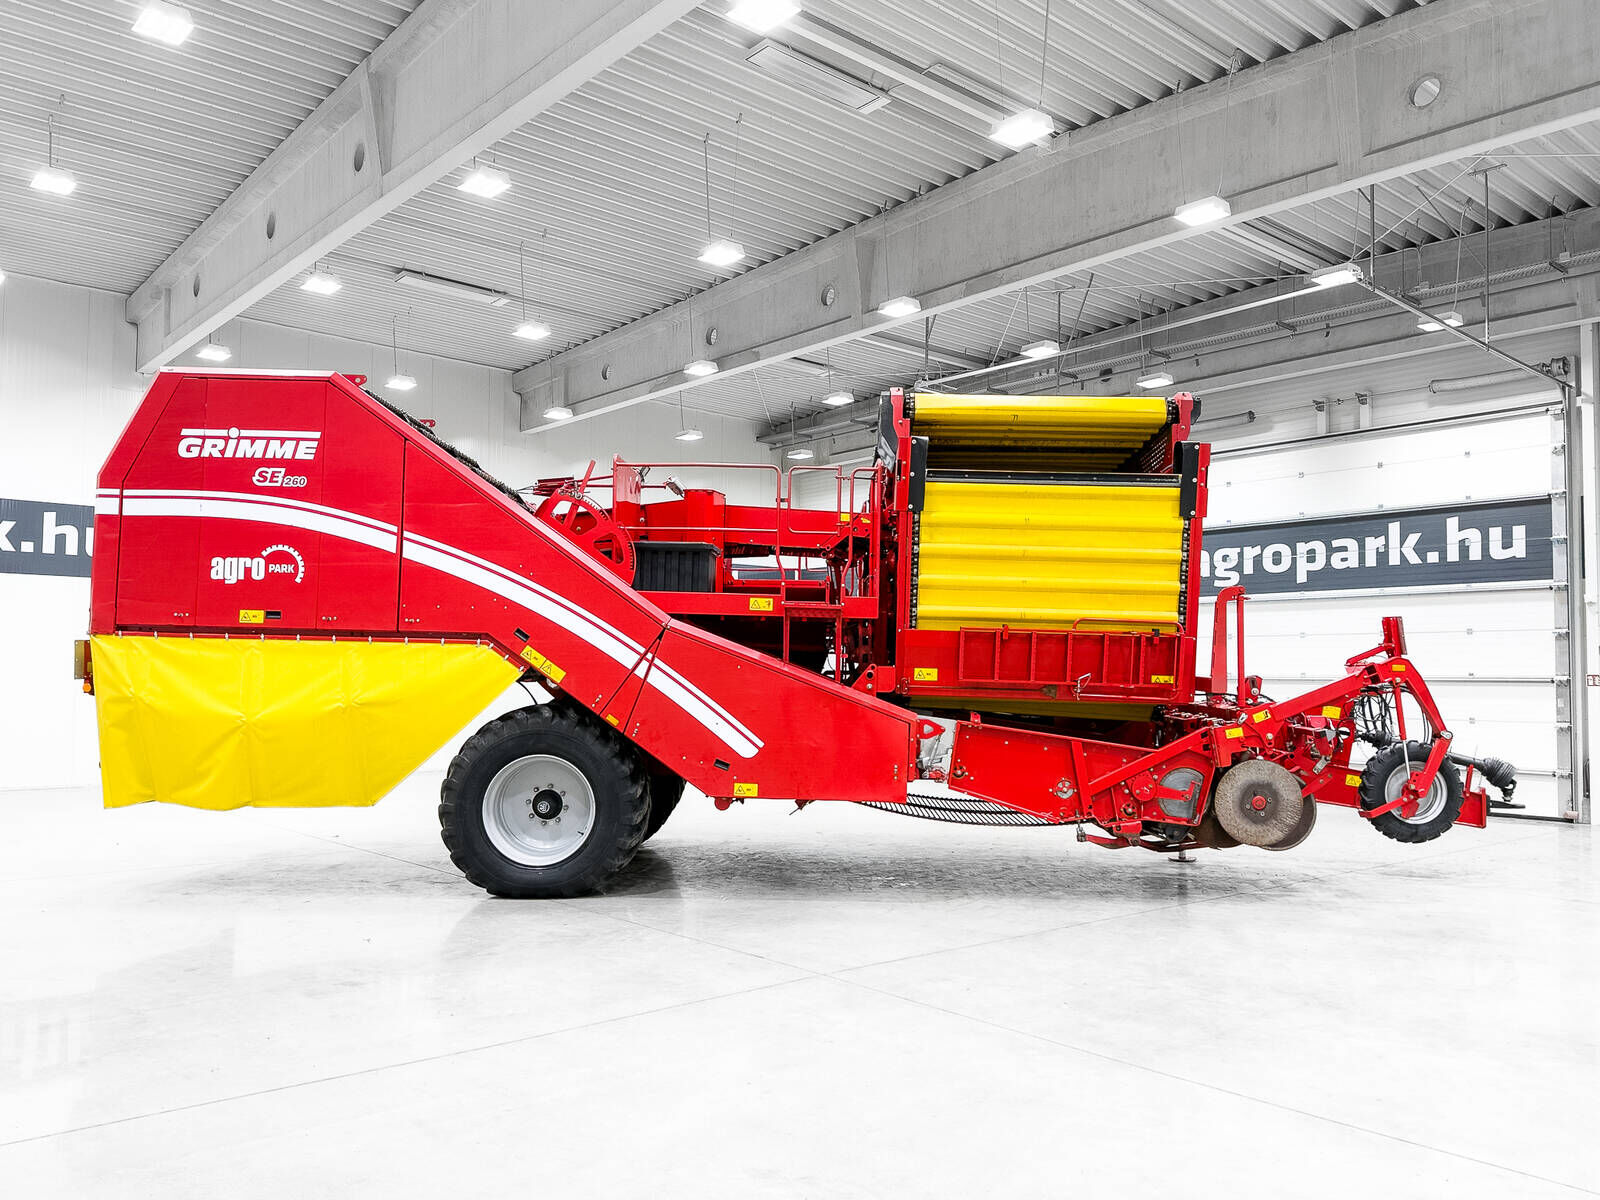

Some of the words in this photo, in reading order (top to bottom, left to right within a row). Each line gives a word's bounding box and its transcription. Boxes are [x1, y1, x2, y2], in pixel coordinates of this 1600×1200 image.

[254, 468, 284, 486] SE
[284, 476, 307, 487] 260
[0, 511, 94, 557] .h
[210, 556, 265, 584] agro
[268, 564, 294, 573] PARK
